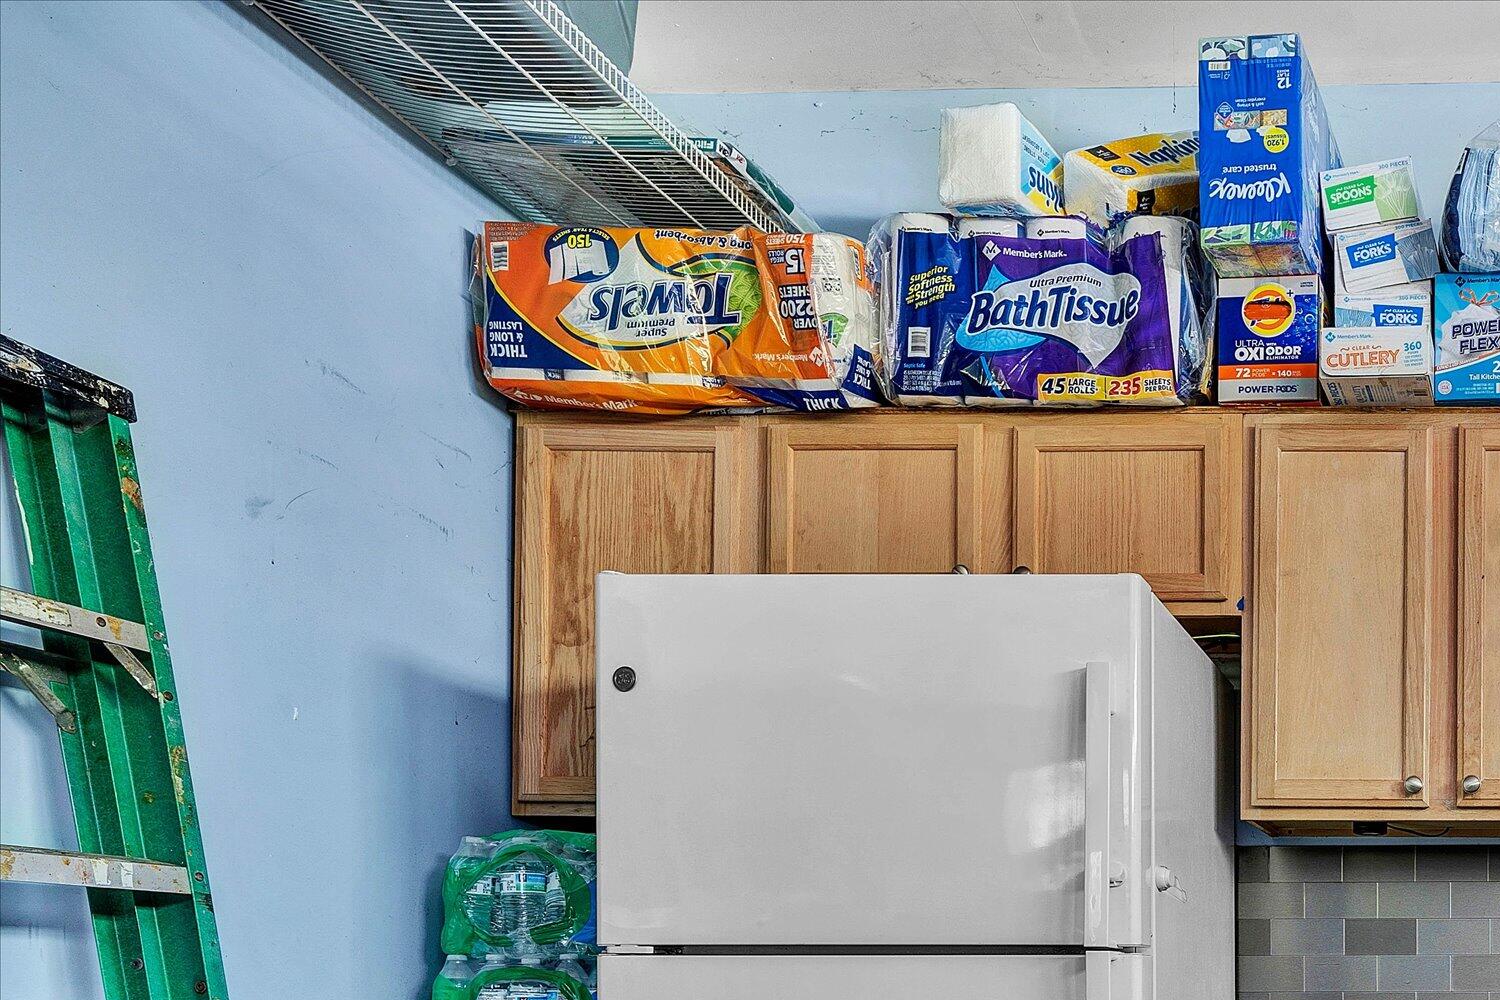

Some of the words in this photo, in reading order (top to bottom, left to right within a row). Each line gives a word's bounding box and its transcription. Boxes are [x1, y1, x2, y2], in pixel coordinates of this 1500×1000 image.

[1277, 77, 1292, 89] 12
[1266, 138, 1286, 146] 1,920
[1222, 166, 1242, 174] care
[1243, 164, 1277, 173] trusted
[1389, 160, 1409, 168] PIECES
[1209, 171, 1291, 203] Kleenex
[1330, 185, 1372, 204] SPOONS
[567, 233, 592, 248] 150
[653, 229, 716, 246] Absorbent
[718, 236, 728, 247] &
[768, 249, 785, 257] ROLLS
[1002, 248, 1043, 259] Member's
[1044, 249, 1067, 259] Mark
[1353, 244, 1392, 261] FORKS
[770, 256, 786, 264] MEGA
[785, 248, 805, 274] 15
[909, 265, 948, 284] Superior
[1029, 277, 1055, 288] Ultra
[1055, 273, 1102, 288] Premium
[908, 274, 953, 295] Softness
[914, 282, 955, 301] Strength
[589, 271, 741, 333] Towels
[914, 299, 929, 310] you
[779, 301, 815, 317] 2200
[627, 318, 676, 330] Premium
[793, 317, 819, 330] OVER
[1379, 313, 1418, 324] FORKS
[488, 319, 524, 332] LASTING
[488, 331, 514, 343] LONG
[515, 331, 524, 343] &
[635, 326, 668, 339] Super
[488, 342, 528, 359] THICK
[1235, 340, 1265, 348] ULTRA
[1403, 341, 1422, 351] 360
[1460, 335, 1500, 354] FLEX
[754, 353, 777, 362] Mark
[780, 353, 808, 363] Member's
[1234, 347, 1264, 361] OXI
[1265, 346, 1302, 355] ODOR
[1326, 349, 1400, 368] CUTLERY
[1235, 368, 1251, 378] 72
[1041, 377, 1066, 395] 45
[1067, 378, 1096, 387] LARGE
[1108, 376, 1141, 396] 235
[1143, 379, 1171, 387] SHEETS
[1145, 385, 1158, 393] PER
[1158, 384, 1173, 392] ROLL
[1238, 386, 1274, 394] POWER
[545, 394, 601, 410] Member's
[602, 398, 637, 411] Mark
[803, 397, 843, 412] THICK
